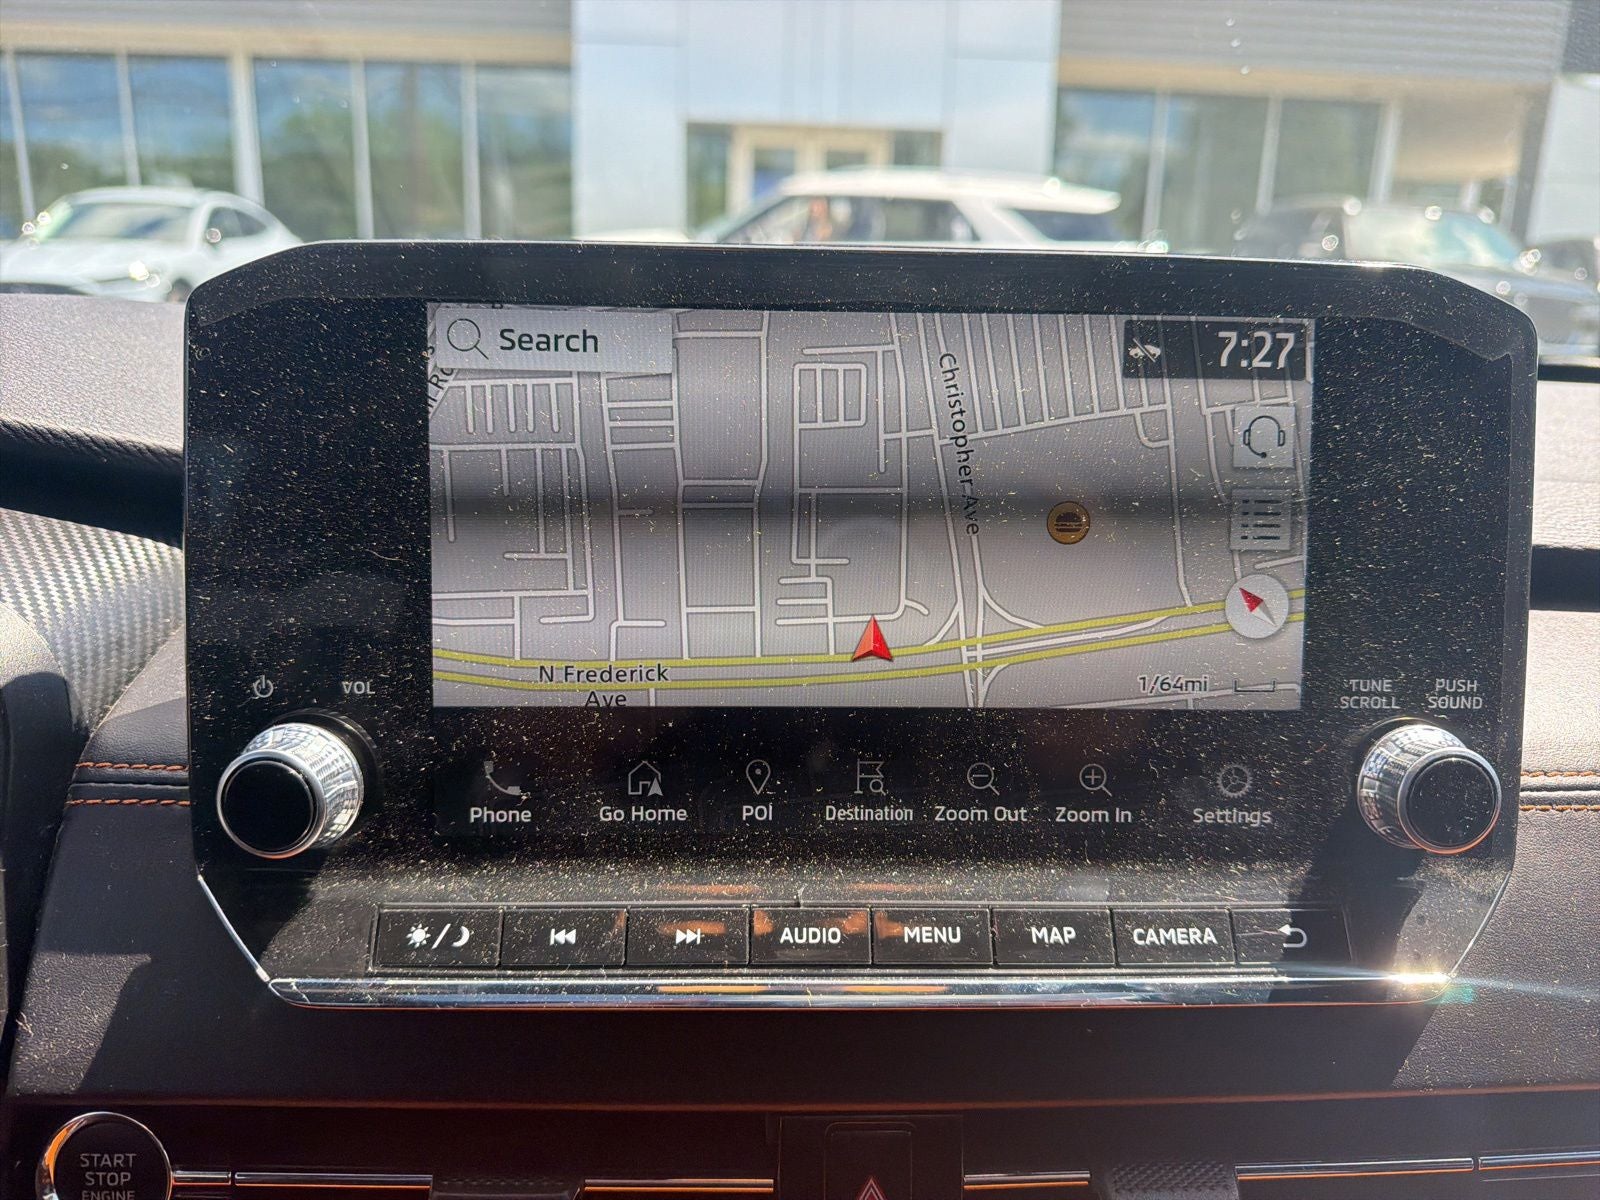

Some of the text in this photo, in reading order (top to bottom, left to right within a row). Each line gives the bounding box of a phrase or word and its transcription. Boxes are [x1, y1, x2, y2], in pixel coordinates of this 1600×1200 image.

[500, 328, 599, 353] Search
[1217, 330, 1296, 369] 7:27
[939, 352, 980, 536] Christopher Ave
[539, 663, 669, 683] N Frederick
[341, 680, 376, 695] VOL
[1138, 676, 1208, 694] 1/64mi
[1349, 679, 1393, 692] TUNE
[1435, 679, 1478, 692] PUSH
[585, 690, 627, 707] Ave
[1340, 695, 1400, 709] SCROLL
[1427, 695, 1483, 709] SOUND
[469, 806, 532, 823] Phone
[600, 806, 688, 822] Go Home
[742, 805, 774, 821] POI
[825, 805, 914, 821] Destination
[934, 806, 1028, 822] Zoom Out
[1055, 807, 1132, 823] Zoom In
[1193, 808, 1272, 827] Settings
[780, 927, 842, 944] AUDIO
[903, 926, 961, 943] MENU
[1031, 926, 1077, 944] MAP
[1132, 927, 1218, 945] CAMERA
[80, 1153, 137, 1168] START
[85, 1171, 132, 1186] STOP
[81, 1190, 136, 1200] ENGINE
